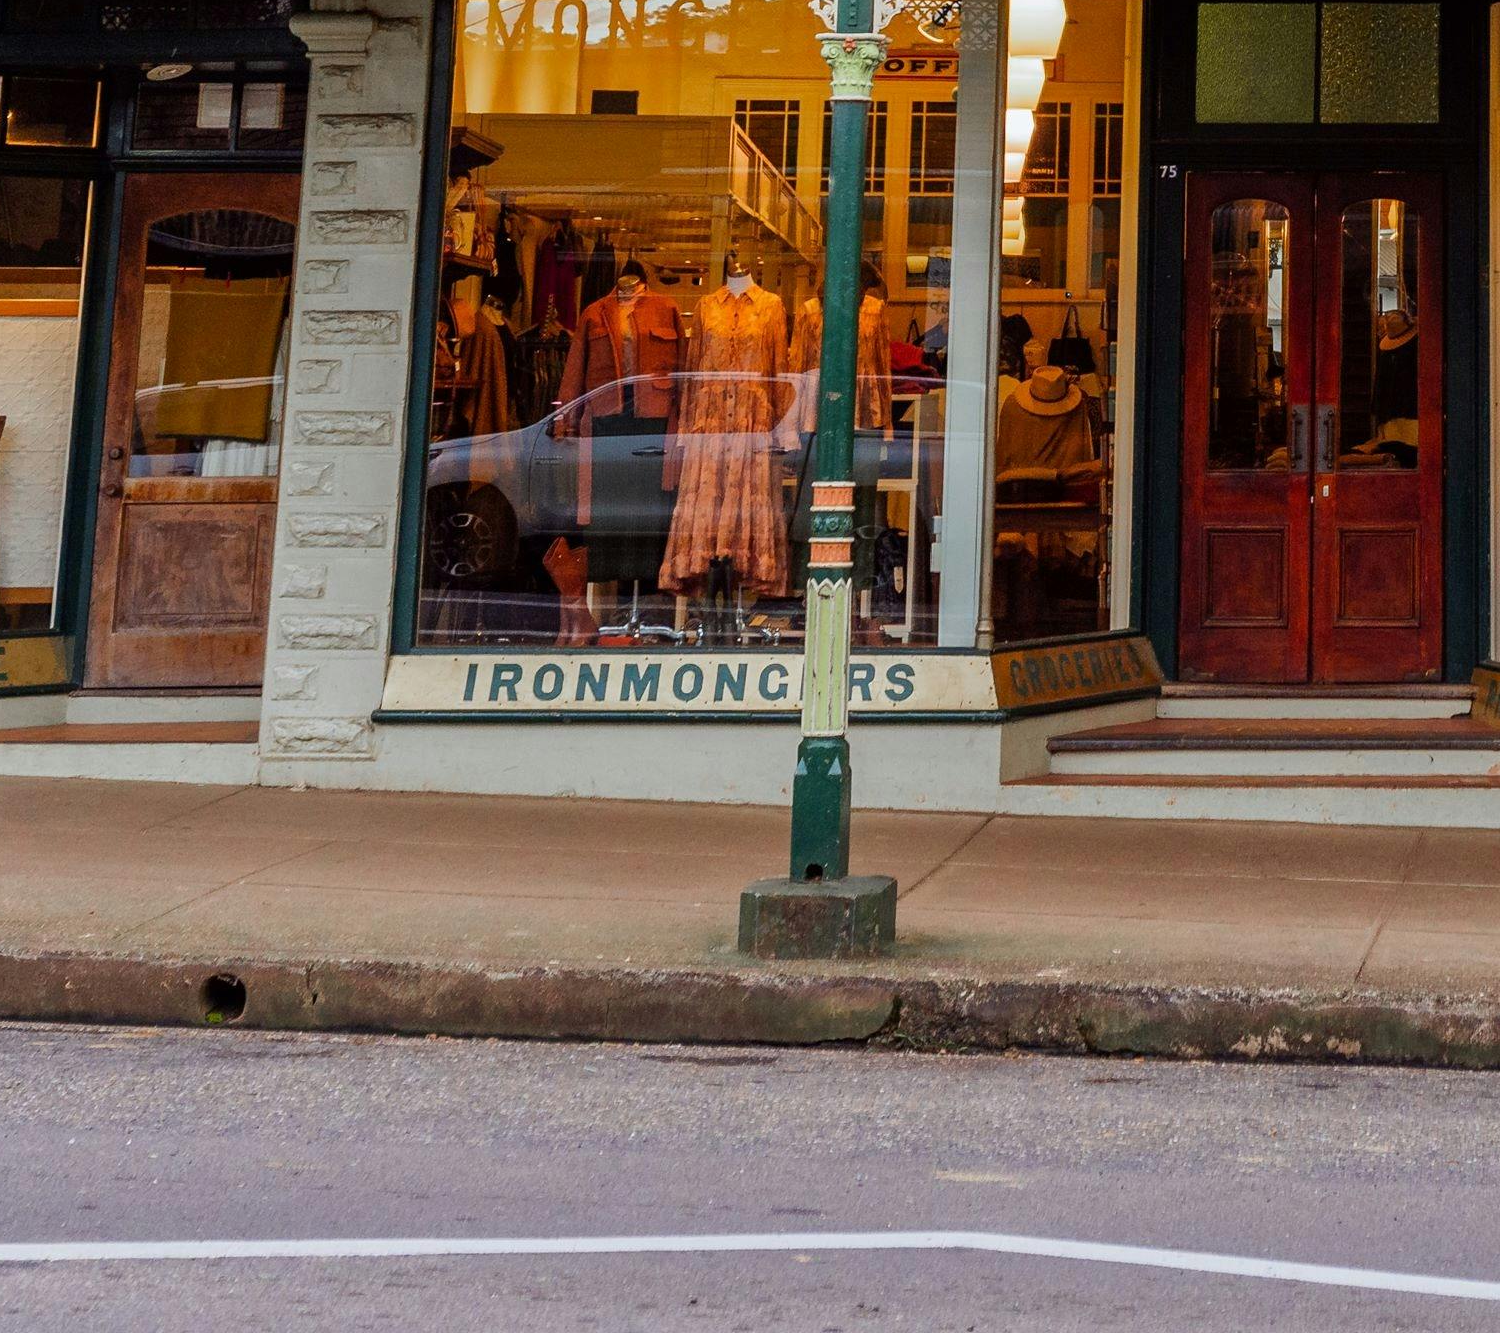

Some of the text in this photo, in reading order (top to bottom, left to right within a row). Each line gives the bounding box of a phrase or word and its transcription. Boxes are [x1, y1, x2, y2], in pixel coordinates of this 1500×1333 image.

[884, 59, 959, 73] OFF
[1160, 165, 1177, 178] 75
[463, 662, 916, 703] IRONMONGRS
[1009, 644, 1145, 698] GROCERIES
